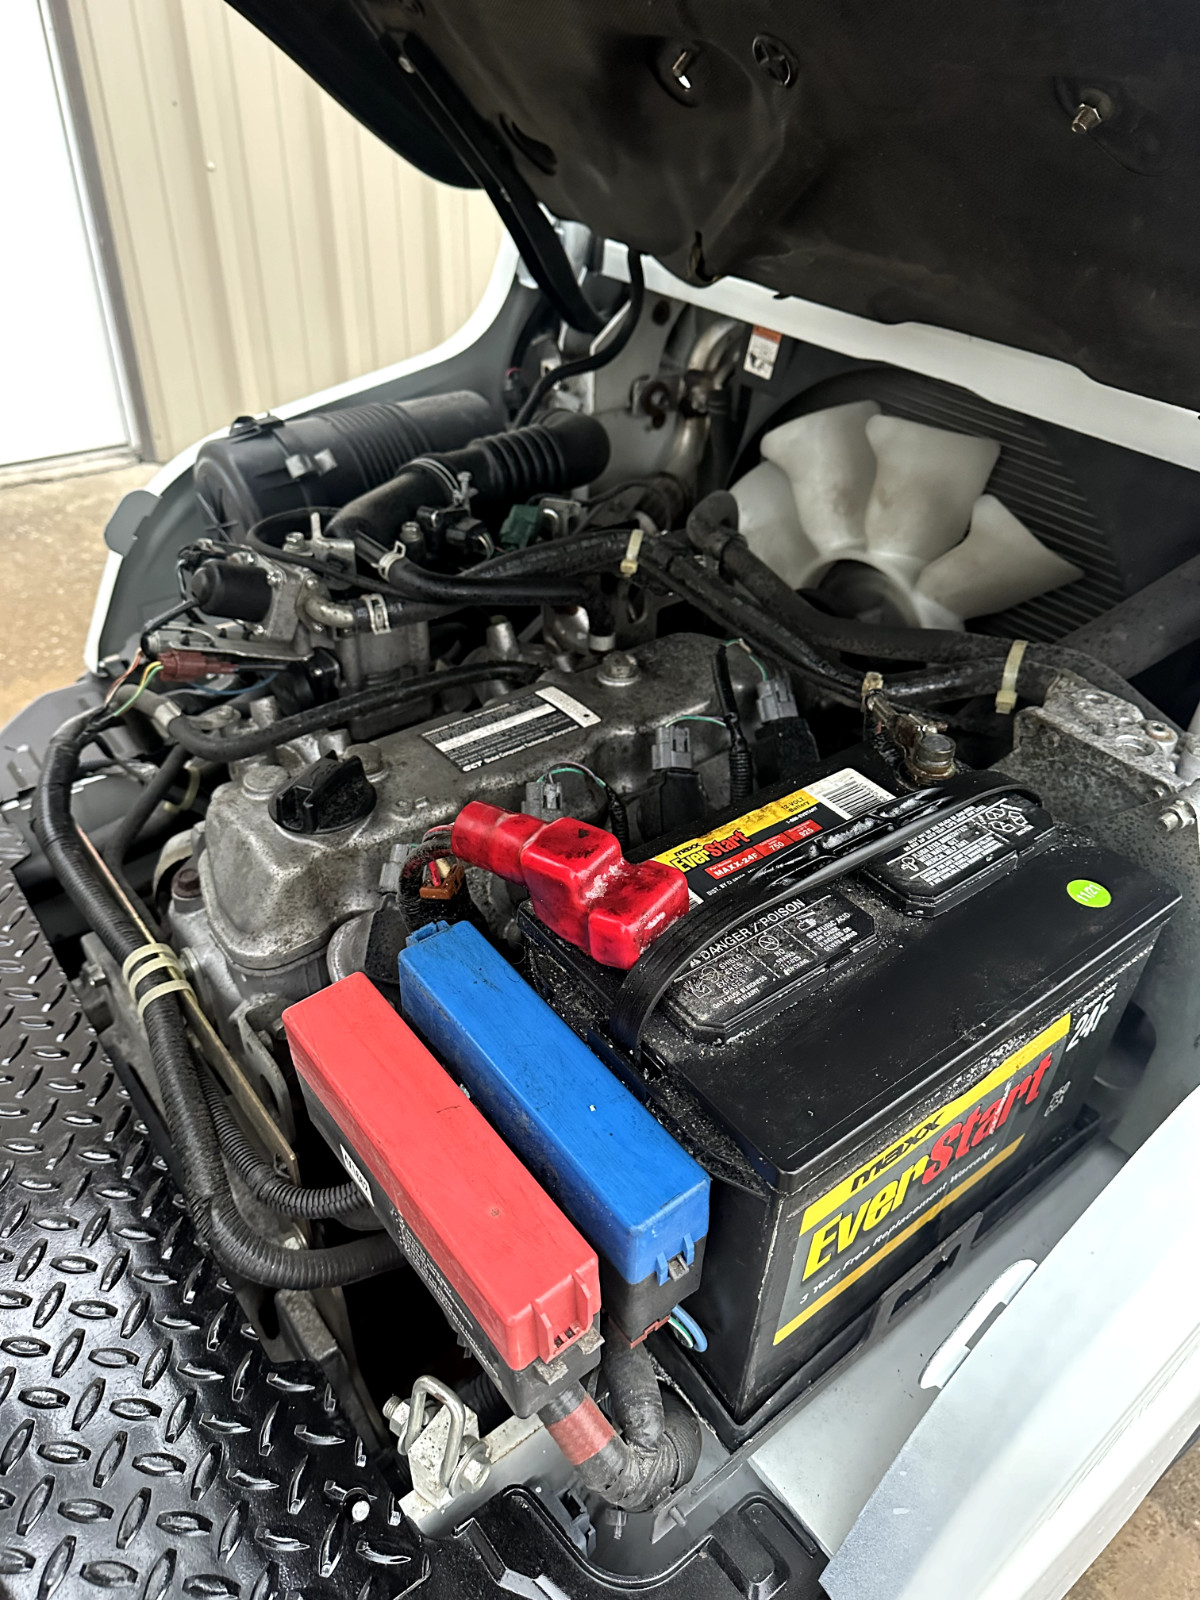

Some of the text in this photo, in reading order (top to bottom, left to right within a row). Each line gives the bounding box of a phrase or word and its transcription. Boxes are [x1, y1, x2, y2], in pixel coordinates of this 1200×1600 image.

[462, 760, 482, 773] GCT
[788, 800, 811, 813] Battery
[669, 829, 751, 874] EverStart
[768, 841, 785, 851] 750
[713, 852, 758, 877] MAXX-24F
[1076, 883, 1102, 902] 11/21
[700, 927, 753, 960] DANGER
[759, 898, 806, 927] POISON
[1065, 992, 1116, 1053] 24F
[802, 1052, 1052, 1283] EverStart
[813, 1268, 842, 1294] Year
[843, 1245, 871, 1271] Free
[873, 1182, 948, 1247] Replacement
[950, 1144, 998, 1184] Warranty
